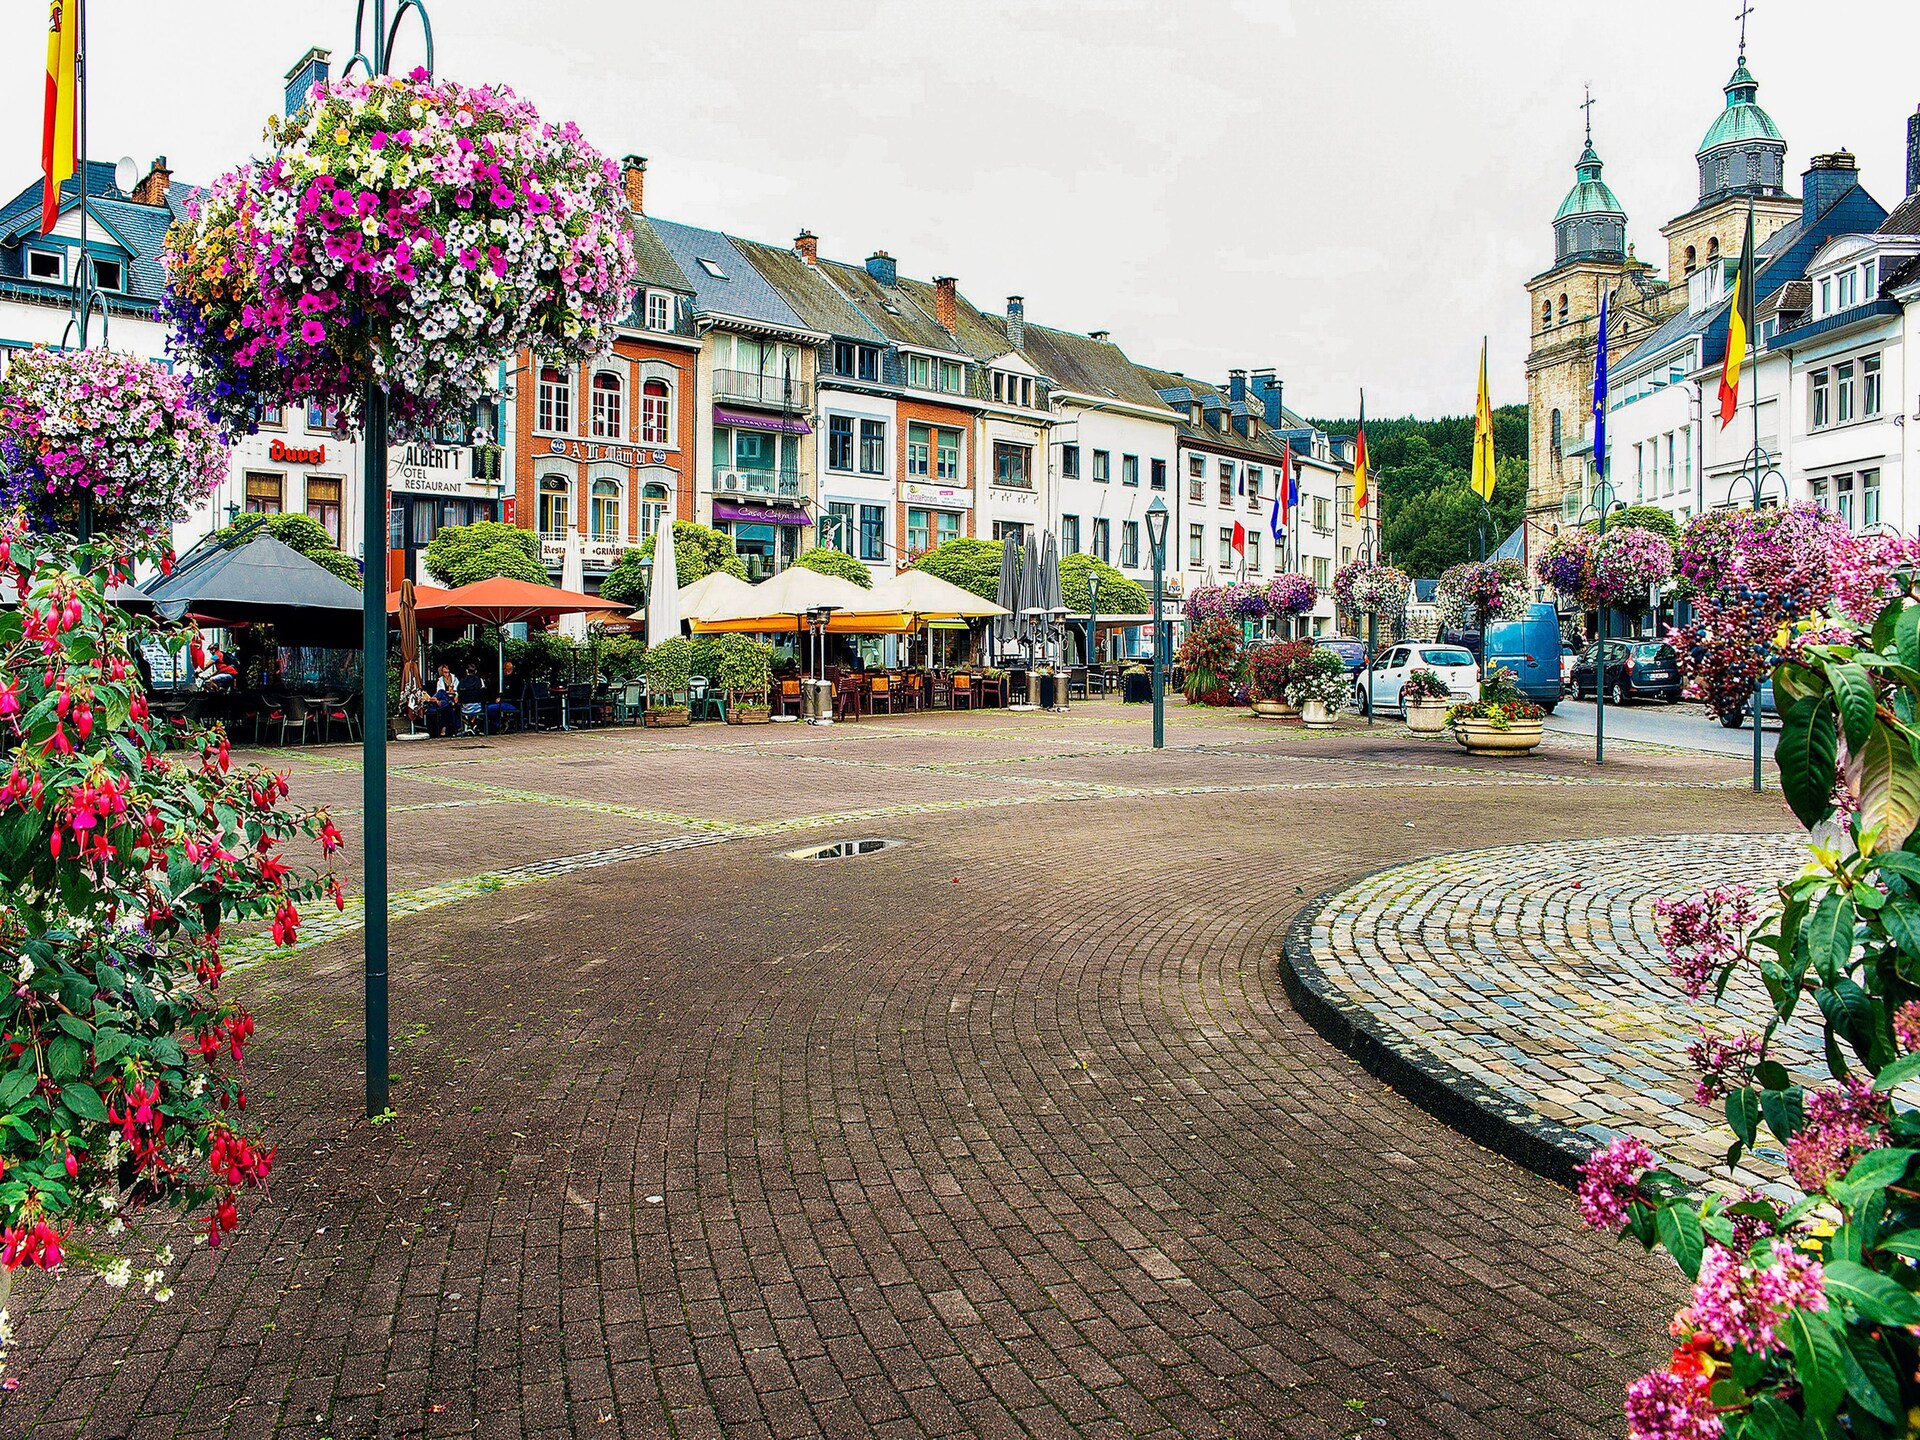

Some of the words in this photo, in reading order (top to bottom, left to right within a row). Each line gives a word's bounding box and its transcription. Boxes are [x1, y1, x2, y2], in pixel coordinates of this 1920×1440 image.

[270, 438, 326, 464] Duvel
[406, 446, 450, 469] ALBERT
[405, 479, 462, 492] RESTAURANT
[543, 545, 585, 554] Restant
